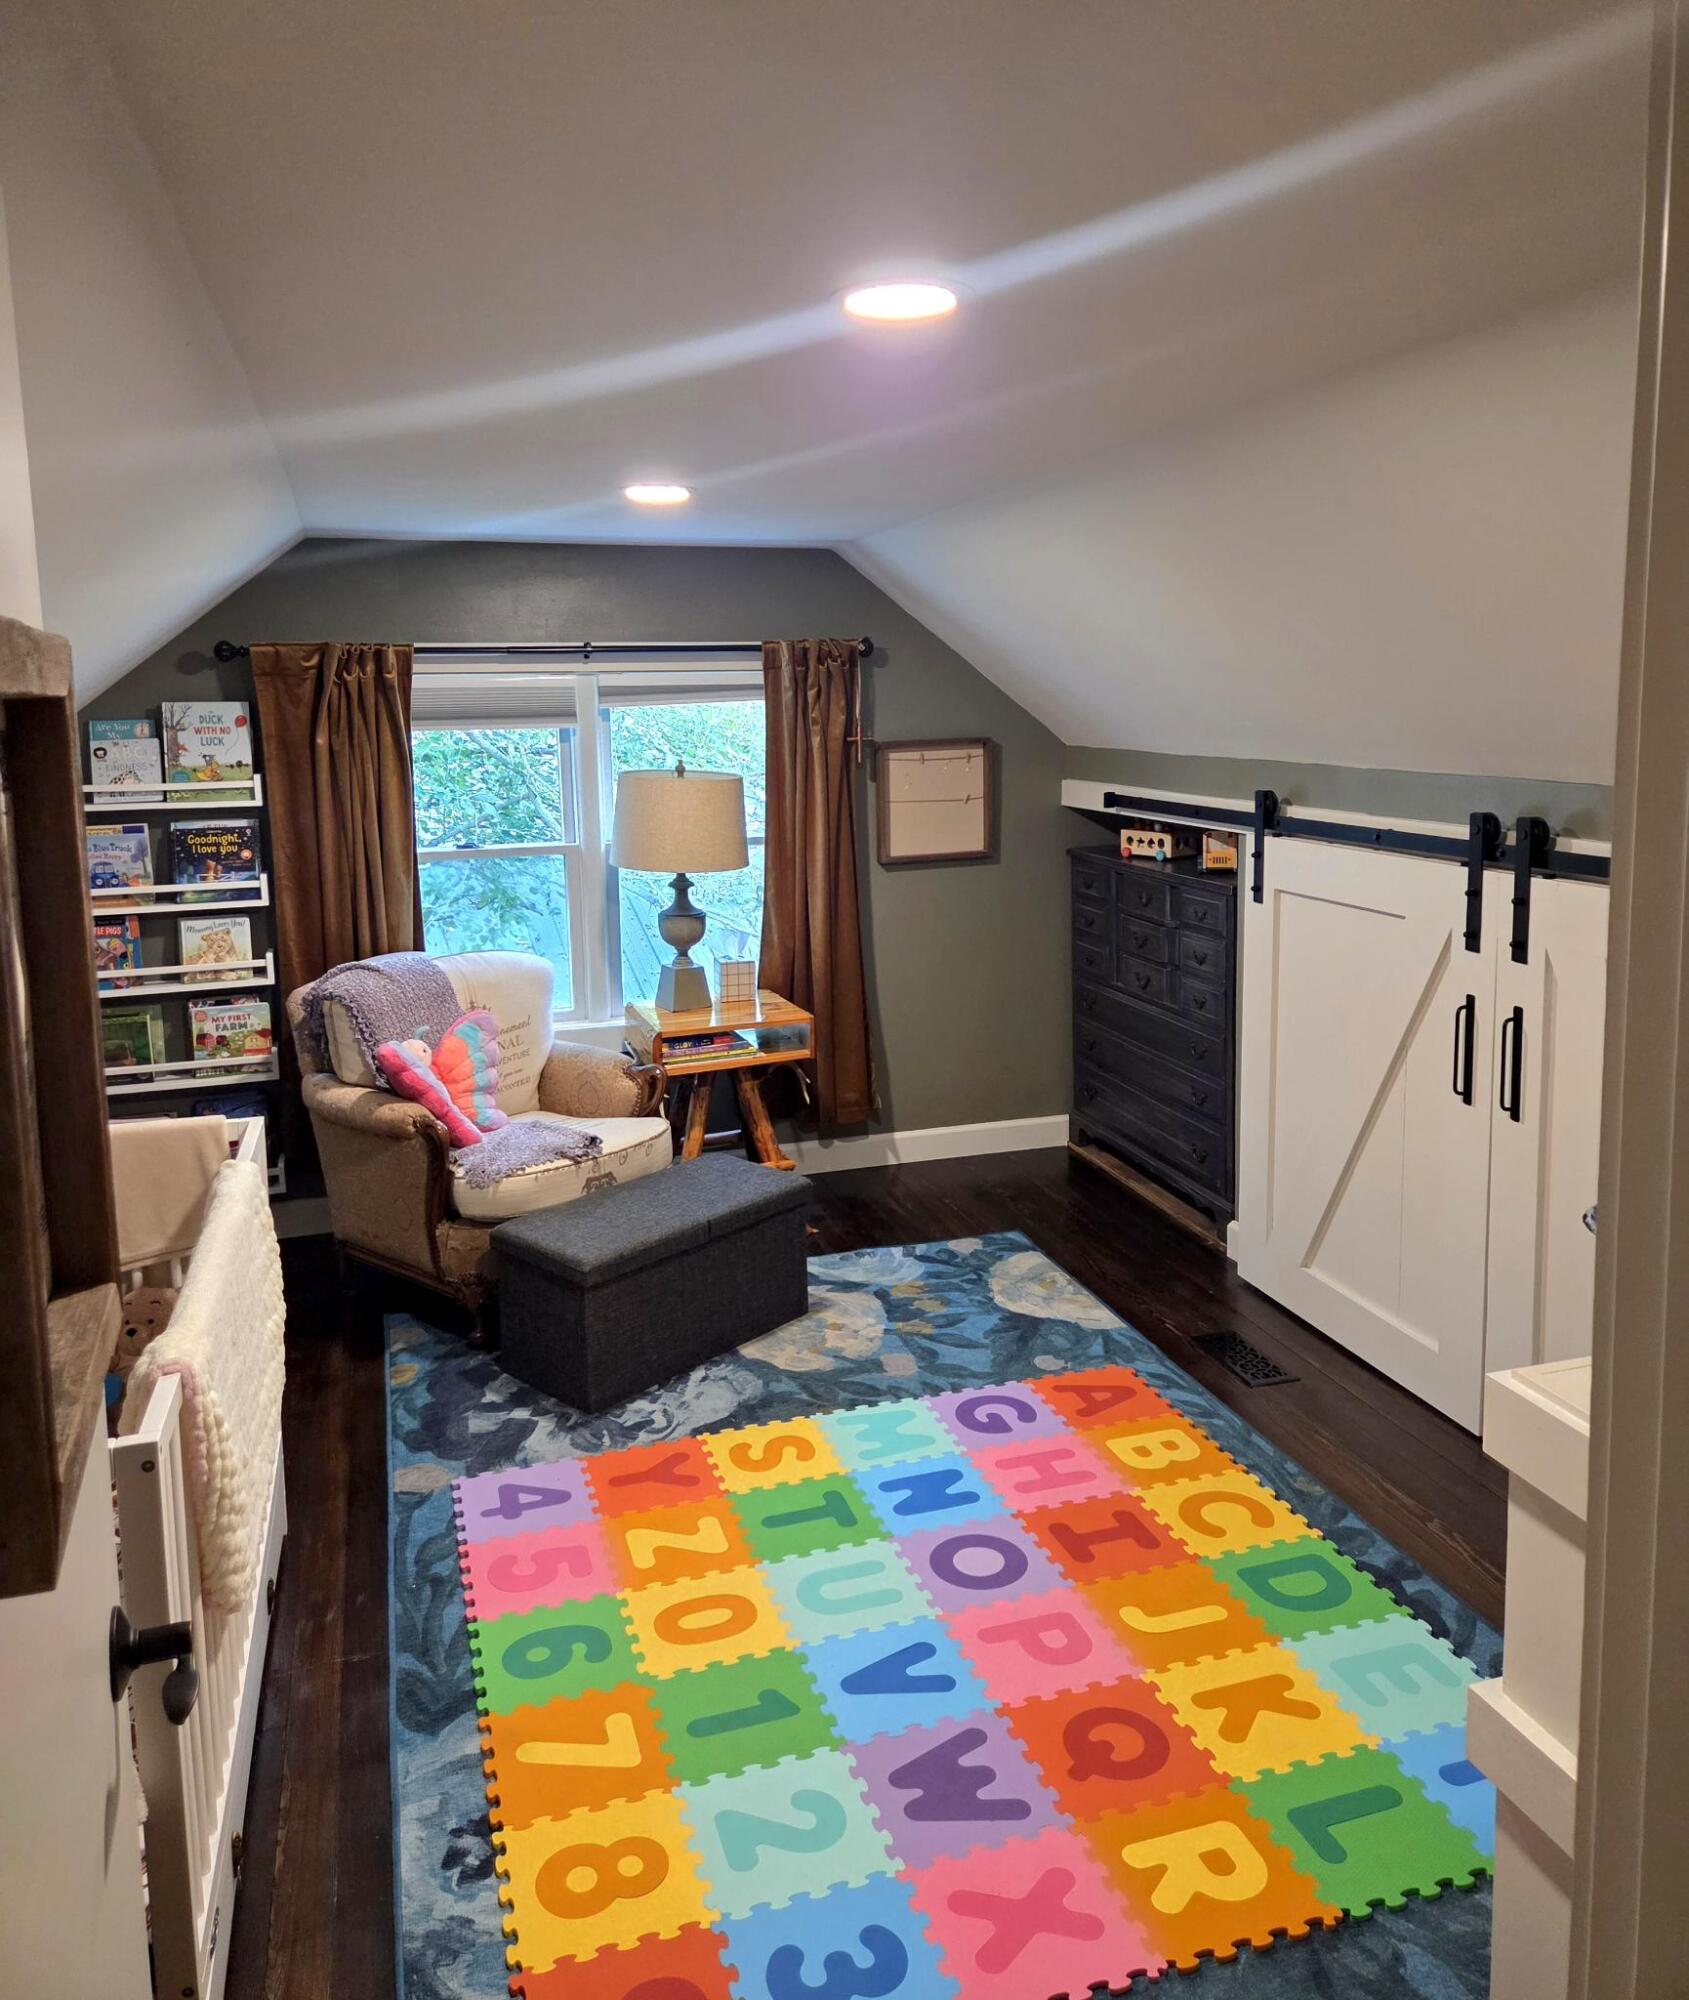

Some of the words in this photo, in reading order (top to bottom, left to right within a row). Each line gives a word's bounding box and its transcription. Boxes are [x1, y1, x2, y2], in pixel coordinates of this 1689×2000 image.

[192, 726, 217, 735] WITH
[219, 726, 231, 735] NO
[199, 714, 224, 725] DUCK
[200, 736, 225, 746] LUCK
[197, 845, 217, 854] love
[220, 844, 238, 856] you
[105, 926, 121, 936] PIGS
[211, 1015, 225, 1024] MY
[227, 1013, 251, 1022] FIRST
[215, 1021, 249, 1032] FARM
[955, 1395, 1038, 1435] G
[1051, 1385, 1138, 1417] A
[728, 1435, 816, 1473] S
[836, 1411, 935, 1458] M
[1105, 1428, 1200, 1469] B
[608, 1452, 700, 1488] Y
[878, 1469, 980, 1516] N
[994, 1448, 1098, 1494] H
[480, 1483, 572, 1520] 4
[761, 1491, 858, 1528] T
[1177, 1491, 1275, 1539] C
[625, 1516, 729, 1569] Z
[1049, 1510, 1161, 1563] I
[487, 1545, 593, 1593] 5
[929, 1534, 1028, 1590] O
[1236, 1554, 1352, 1611] D
[796, 1560, 904, 1615] U
[977, 1611, 1093, 1665] P
[1119, 1605, 1228, 1633] J
[502, 1625, 612, 1680] 6
[840, 1642, 957, 1695] V
[1330, 1642, 1462, 1707] E
[686, 1689, 800, 1738] 1
[1190, 1673, 1321, 1744] K
[515, 1712, 641, 1768] 7
[1062, 1707, 1170, 1783] Q
[888, 1728, 1032, 1822] W
[714, 1789, 847, 1873] 2
[1287, 1785, 1403, 1865] L
[535, 1836, 669, 1920] 8
[1122, 1821, 1269, 1914] R
[947, 1867, 1105, 1975] X
[766, 1925, 909, 2000] 3
